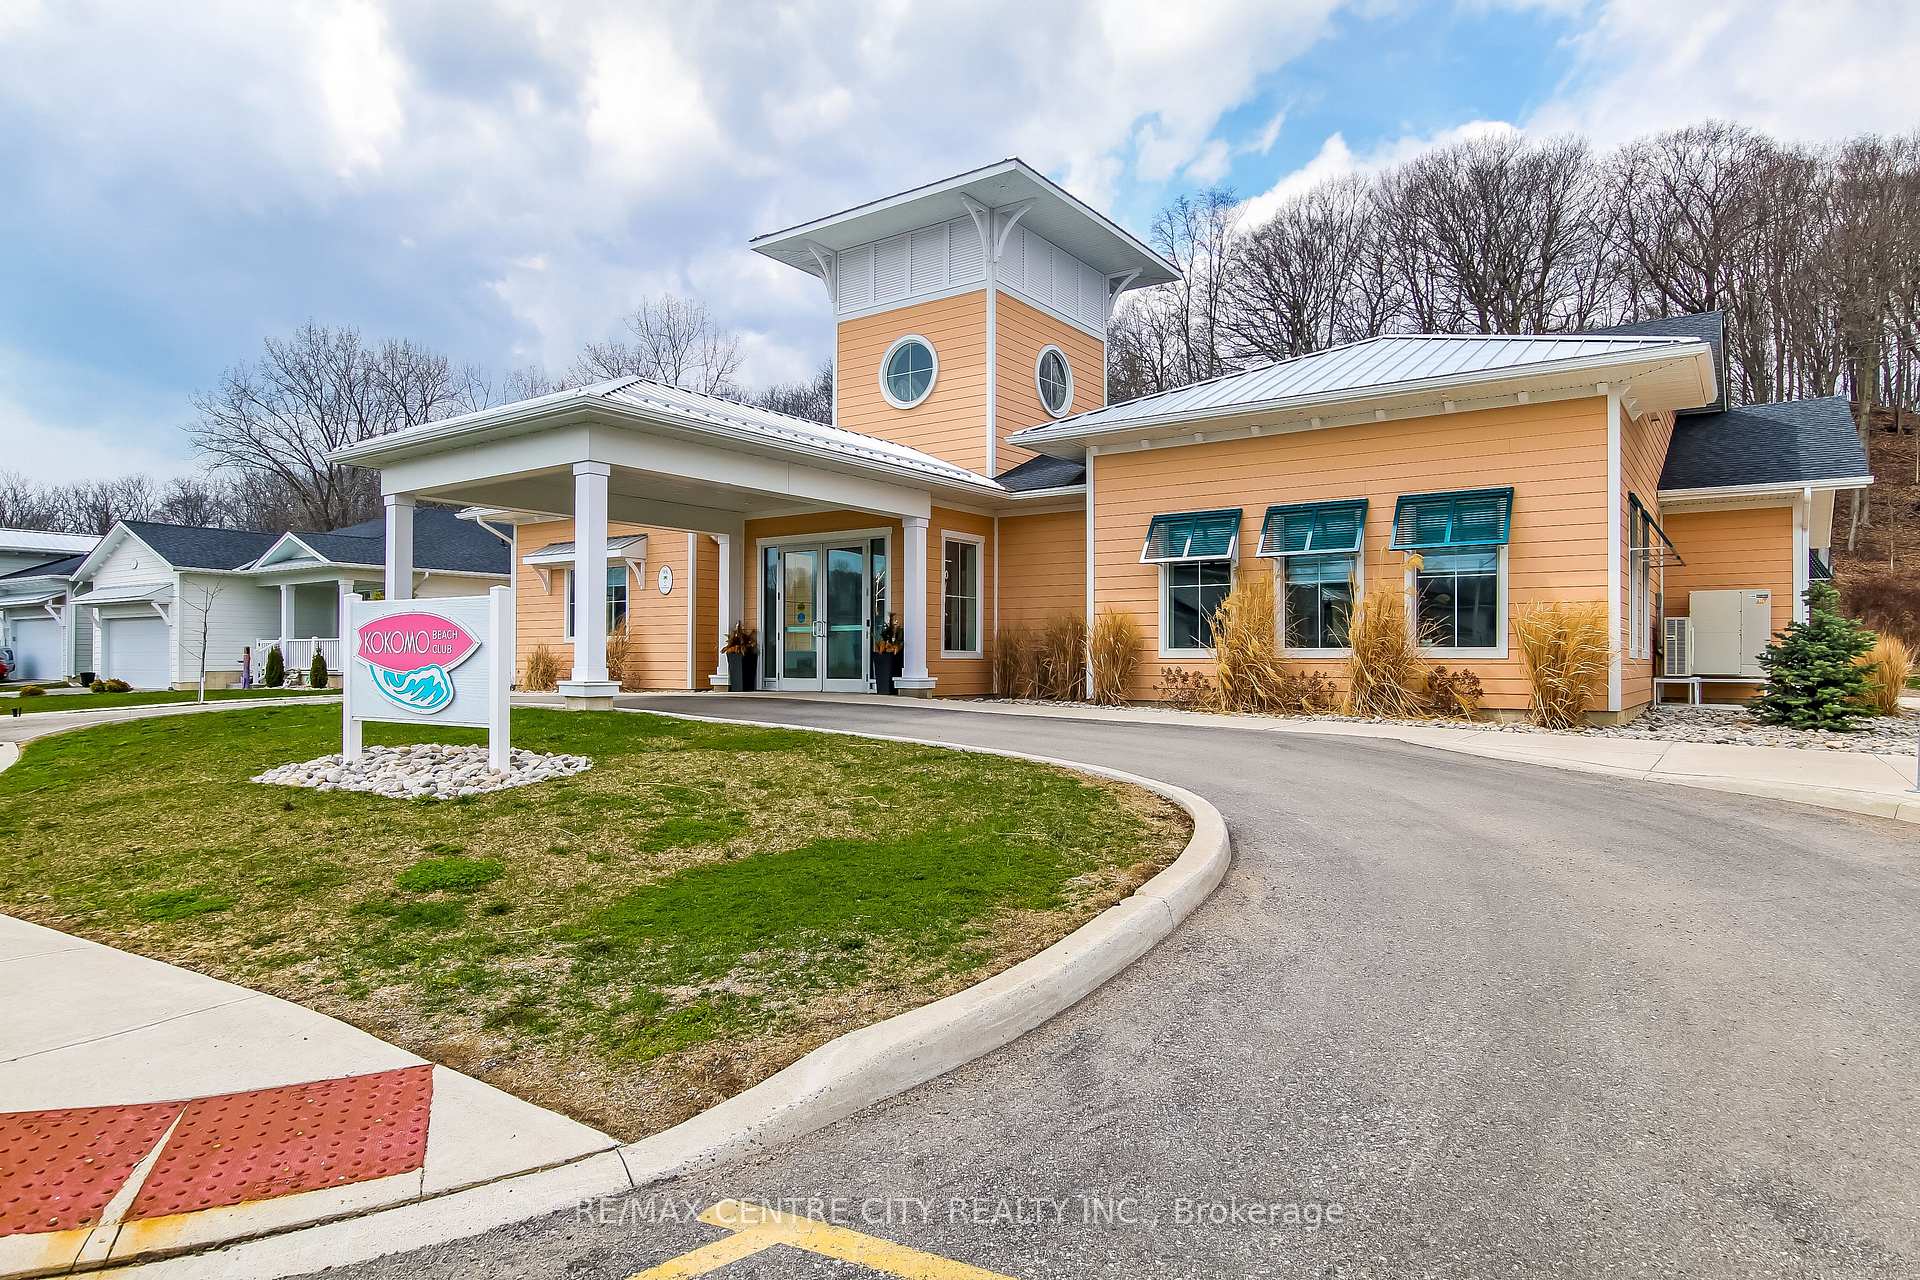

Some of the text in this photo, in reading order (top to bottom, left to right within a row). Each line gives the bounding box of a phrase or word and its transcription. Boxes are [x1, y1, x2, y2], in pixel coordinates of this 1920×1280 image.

[431, 630, 458, 640] BEACH
[363, 631, 430, 654] KOKOMO
[431, 644, 453, 654] CLUB
